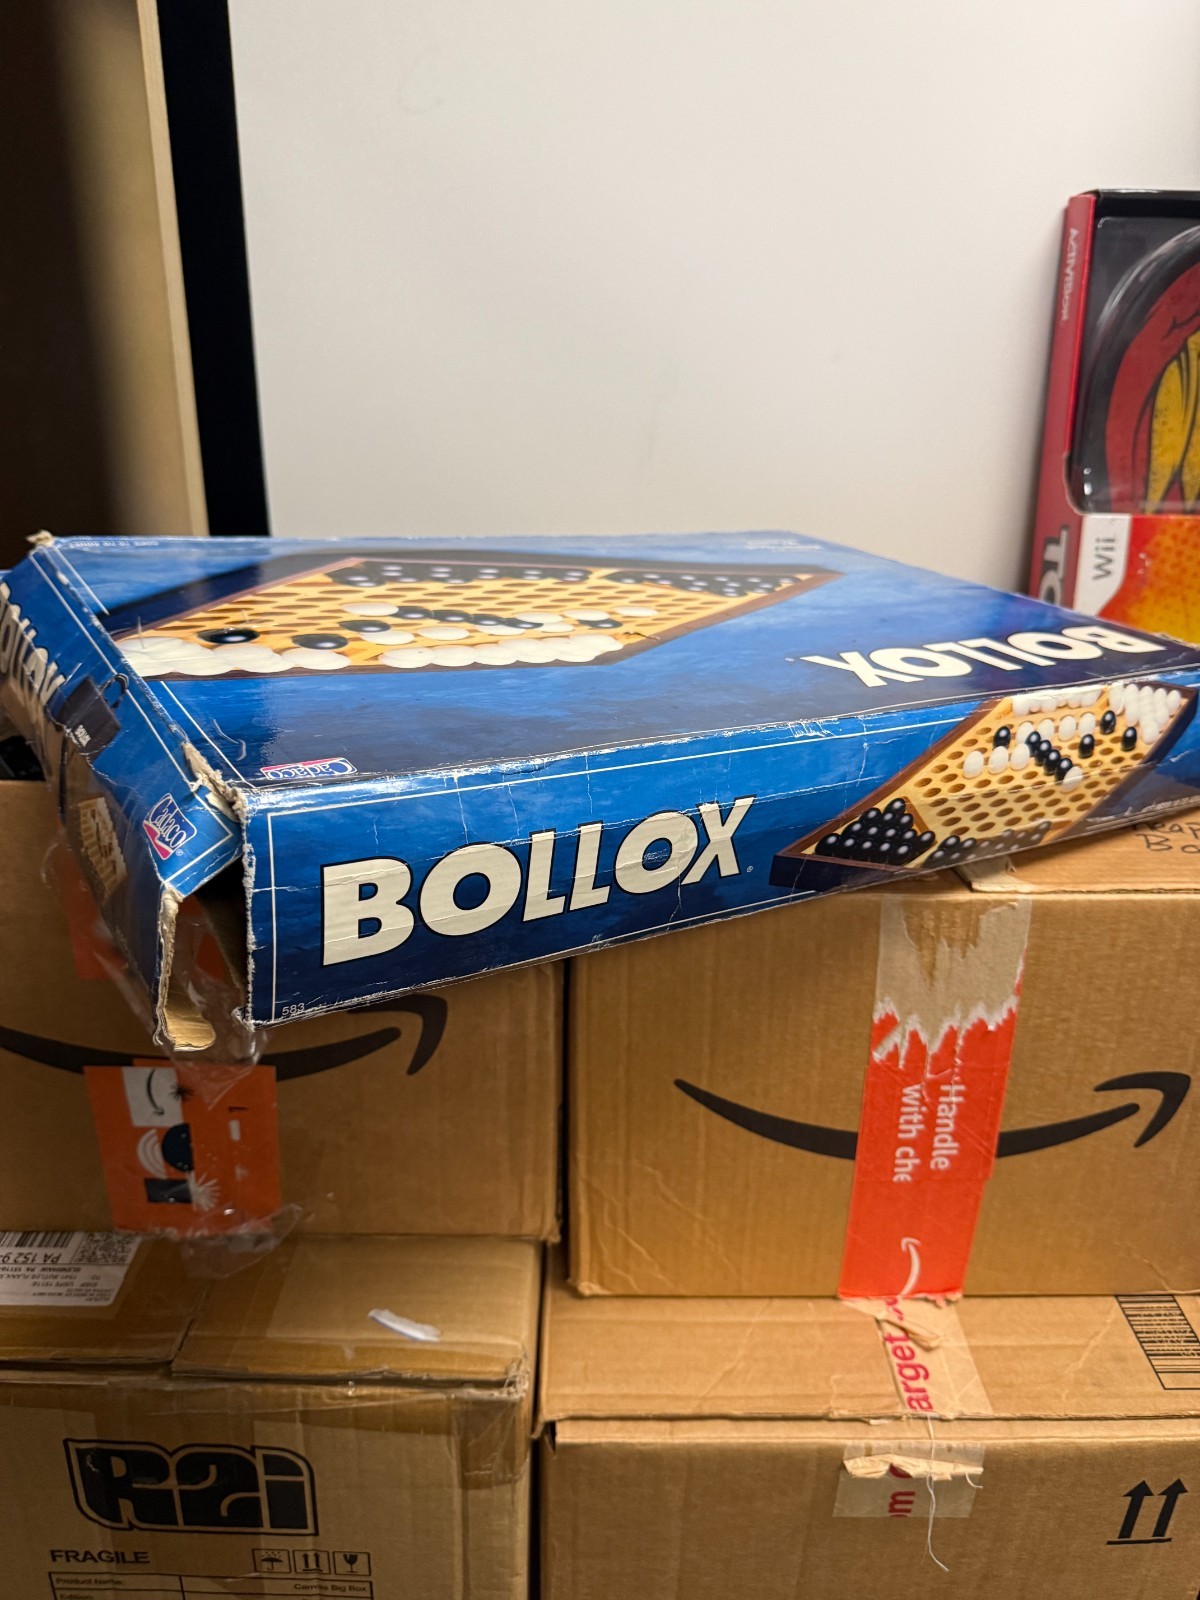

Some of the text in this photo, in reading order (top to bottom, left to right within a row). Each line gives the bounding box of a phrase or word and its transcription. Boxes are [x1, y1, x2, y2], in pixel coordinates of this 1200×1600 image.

[1091, 534, 1115, 582] Wii
[799, 625, 1169, 688] BOLLOX
[149, 796, 187, 848] Cadaco
[321, 796, 755, 966] BOLLOX
[282, 1002, 305, 1018] 583
[898, 1084, 927, 1139] with
[930, 1085, 966, 1170] Handle
[44, 1253, 62, 1263] PA
[50, 1549, 151, 1564] FRAGILE
[331, 1584, 346, 1592] Big
